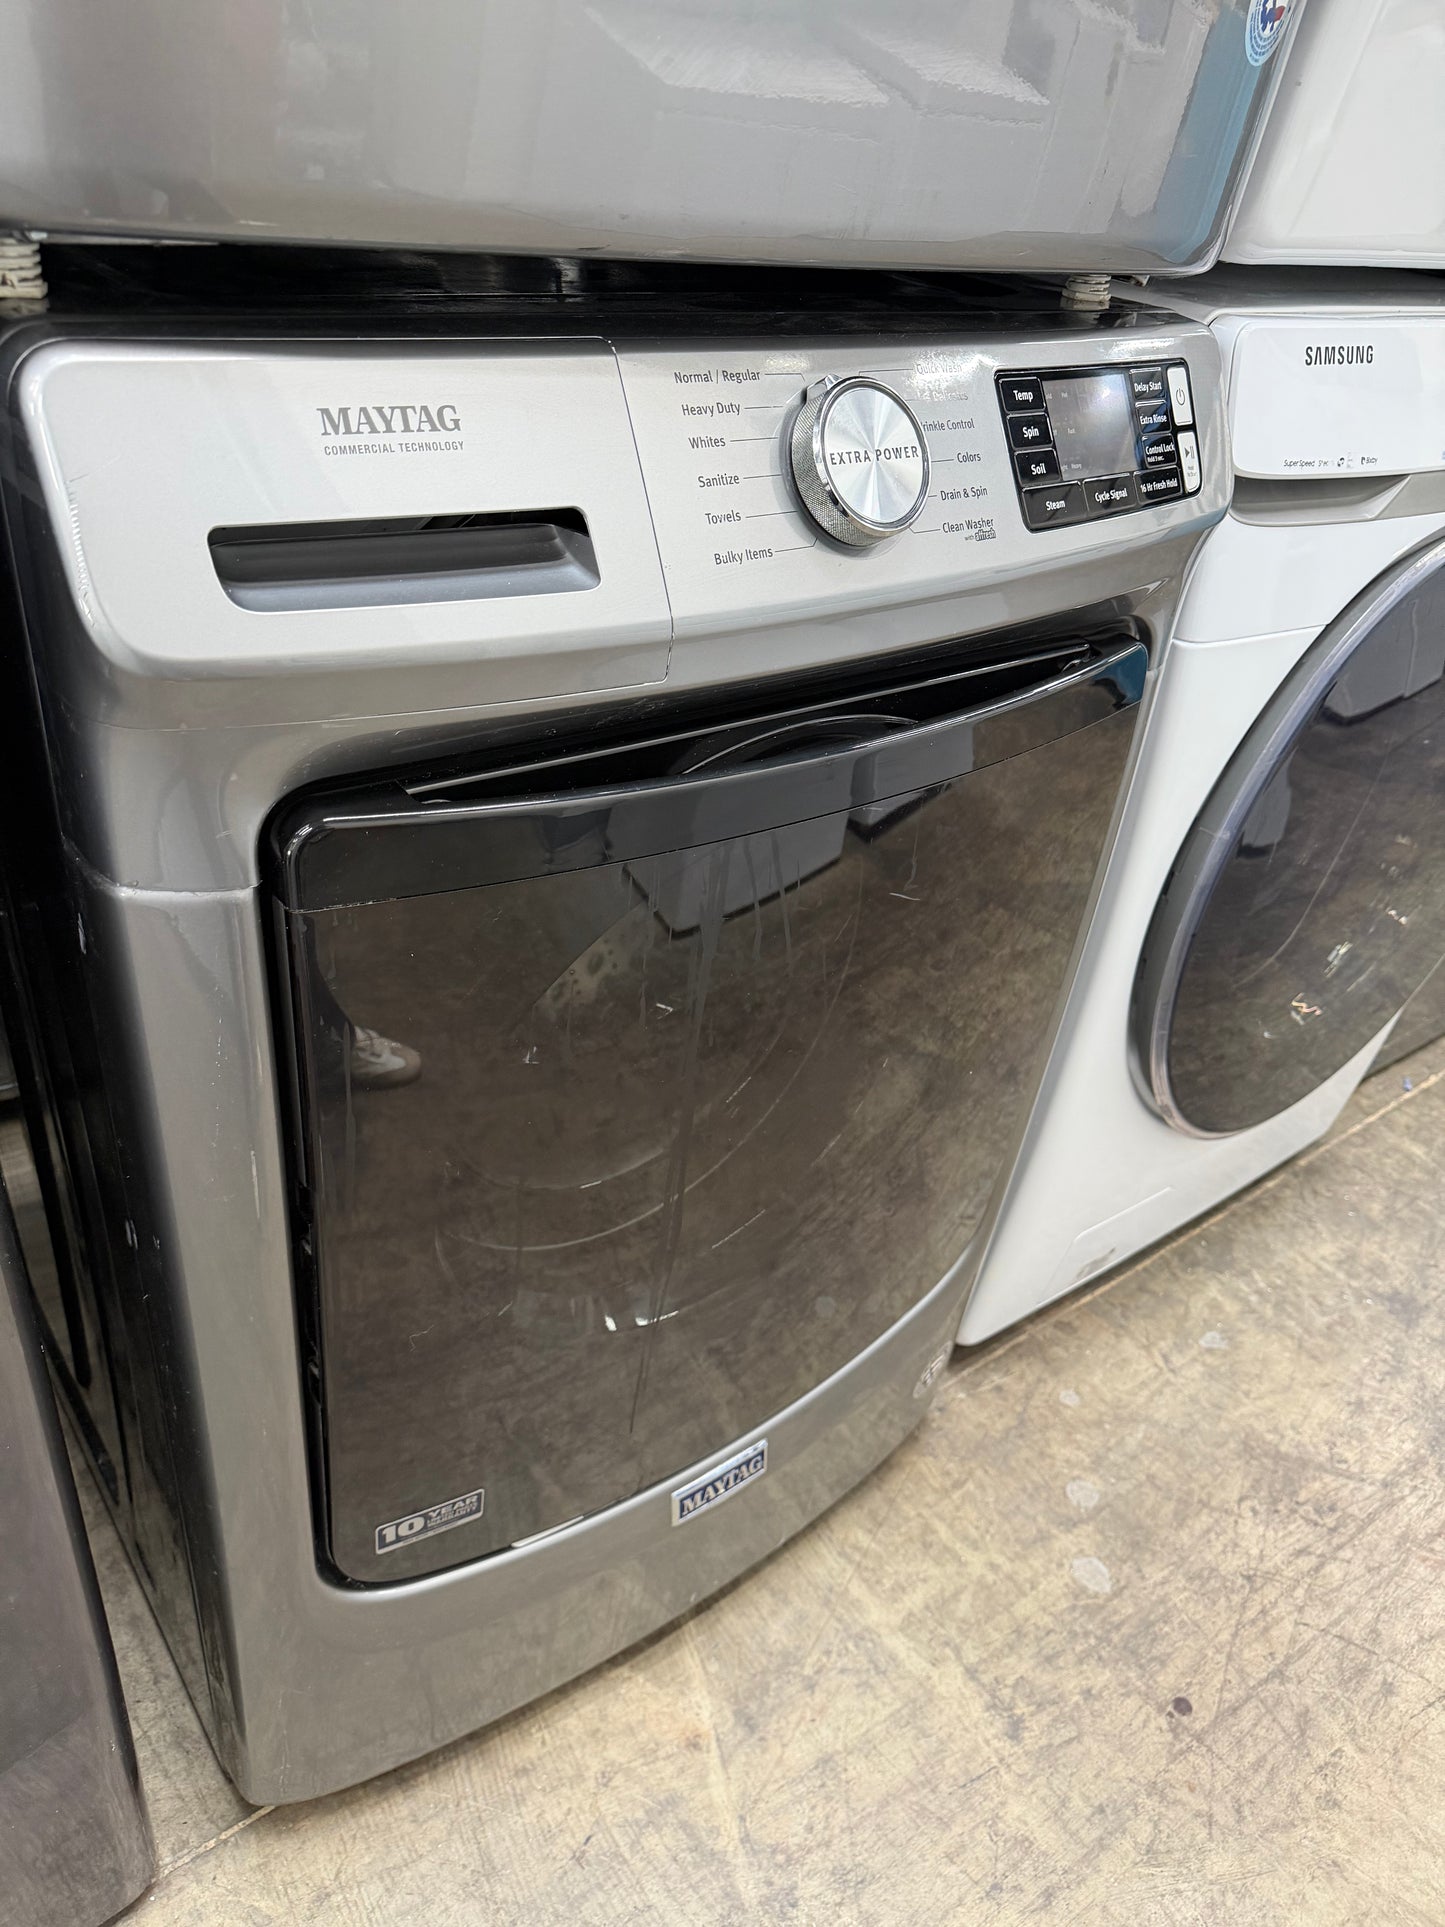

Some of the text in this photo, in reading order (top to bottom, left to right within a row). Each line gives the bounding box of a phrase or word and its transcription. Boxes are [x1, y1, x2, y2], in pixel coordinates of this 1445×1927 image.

[1305, 345, 1374, 366] SAMSUNG
[916, 361, 940, 375] Quick
[674, 369, 714, 384] Normal
[721, 368, 761, 384] Regular
[1134, 380, 1162, 394] Delay Start
[1013, 389, 1034, 403] Temp
[681, 401, 741, 417] Heavy Duty
[316, 404, 462, 436] MAYTAG
[920, 418, 975, 432] rinkle Control
[1139, 413, 1168, 425] Extra Rinse
[1022, 426, 1040, 440] Spin
[324, 440, 464, 456] COMMERCIAL TECHNOLOGY
[688, 435, 726, 449] Whites
[1145, 442, 1175, 455] Control Lock
[829, 445, 919, 466] EXTRA POWER
[956, 451, 982, 464] Colors
[1031, 463, 1047, 475] Soil
[697, 473, 741, 488] Sanitize
[1147, 483, 1154, 493] Hr
[1153, 480, 1166, 491] Fresh
[1166, 478, 1178, 489] Hold
[940, 485, 988, 501] Drain & Spin
[1094, 488, 1128, 504] Cycle Signal
[1046, 499, 1066, 511] Steam
[705, 510, 742, 525] Towels
[942, 517, 994, 534] Clean Washer
[714, 547, 773, 566] Bulky Items
[682, 1454, 763, 1515] MAYTAG
[382, 1516, 425, 1544] 10
